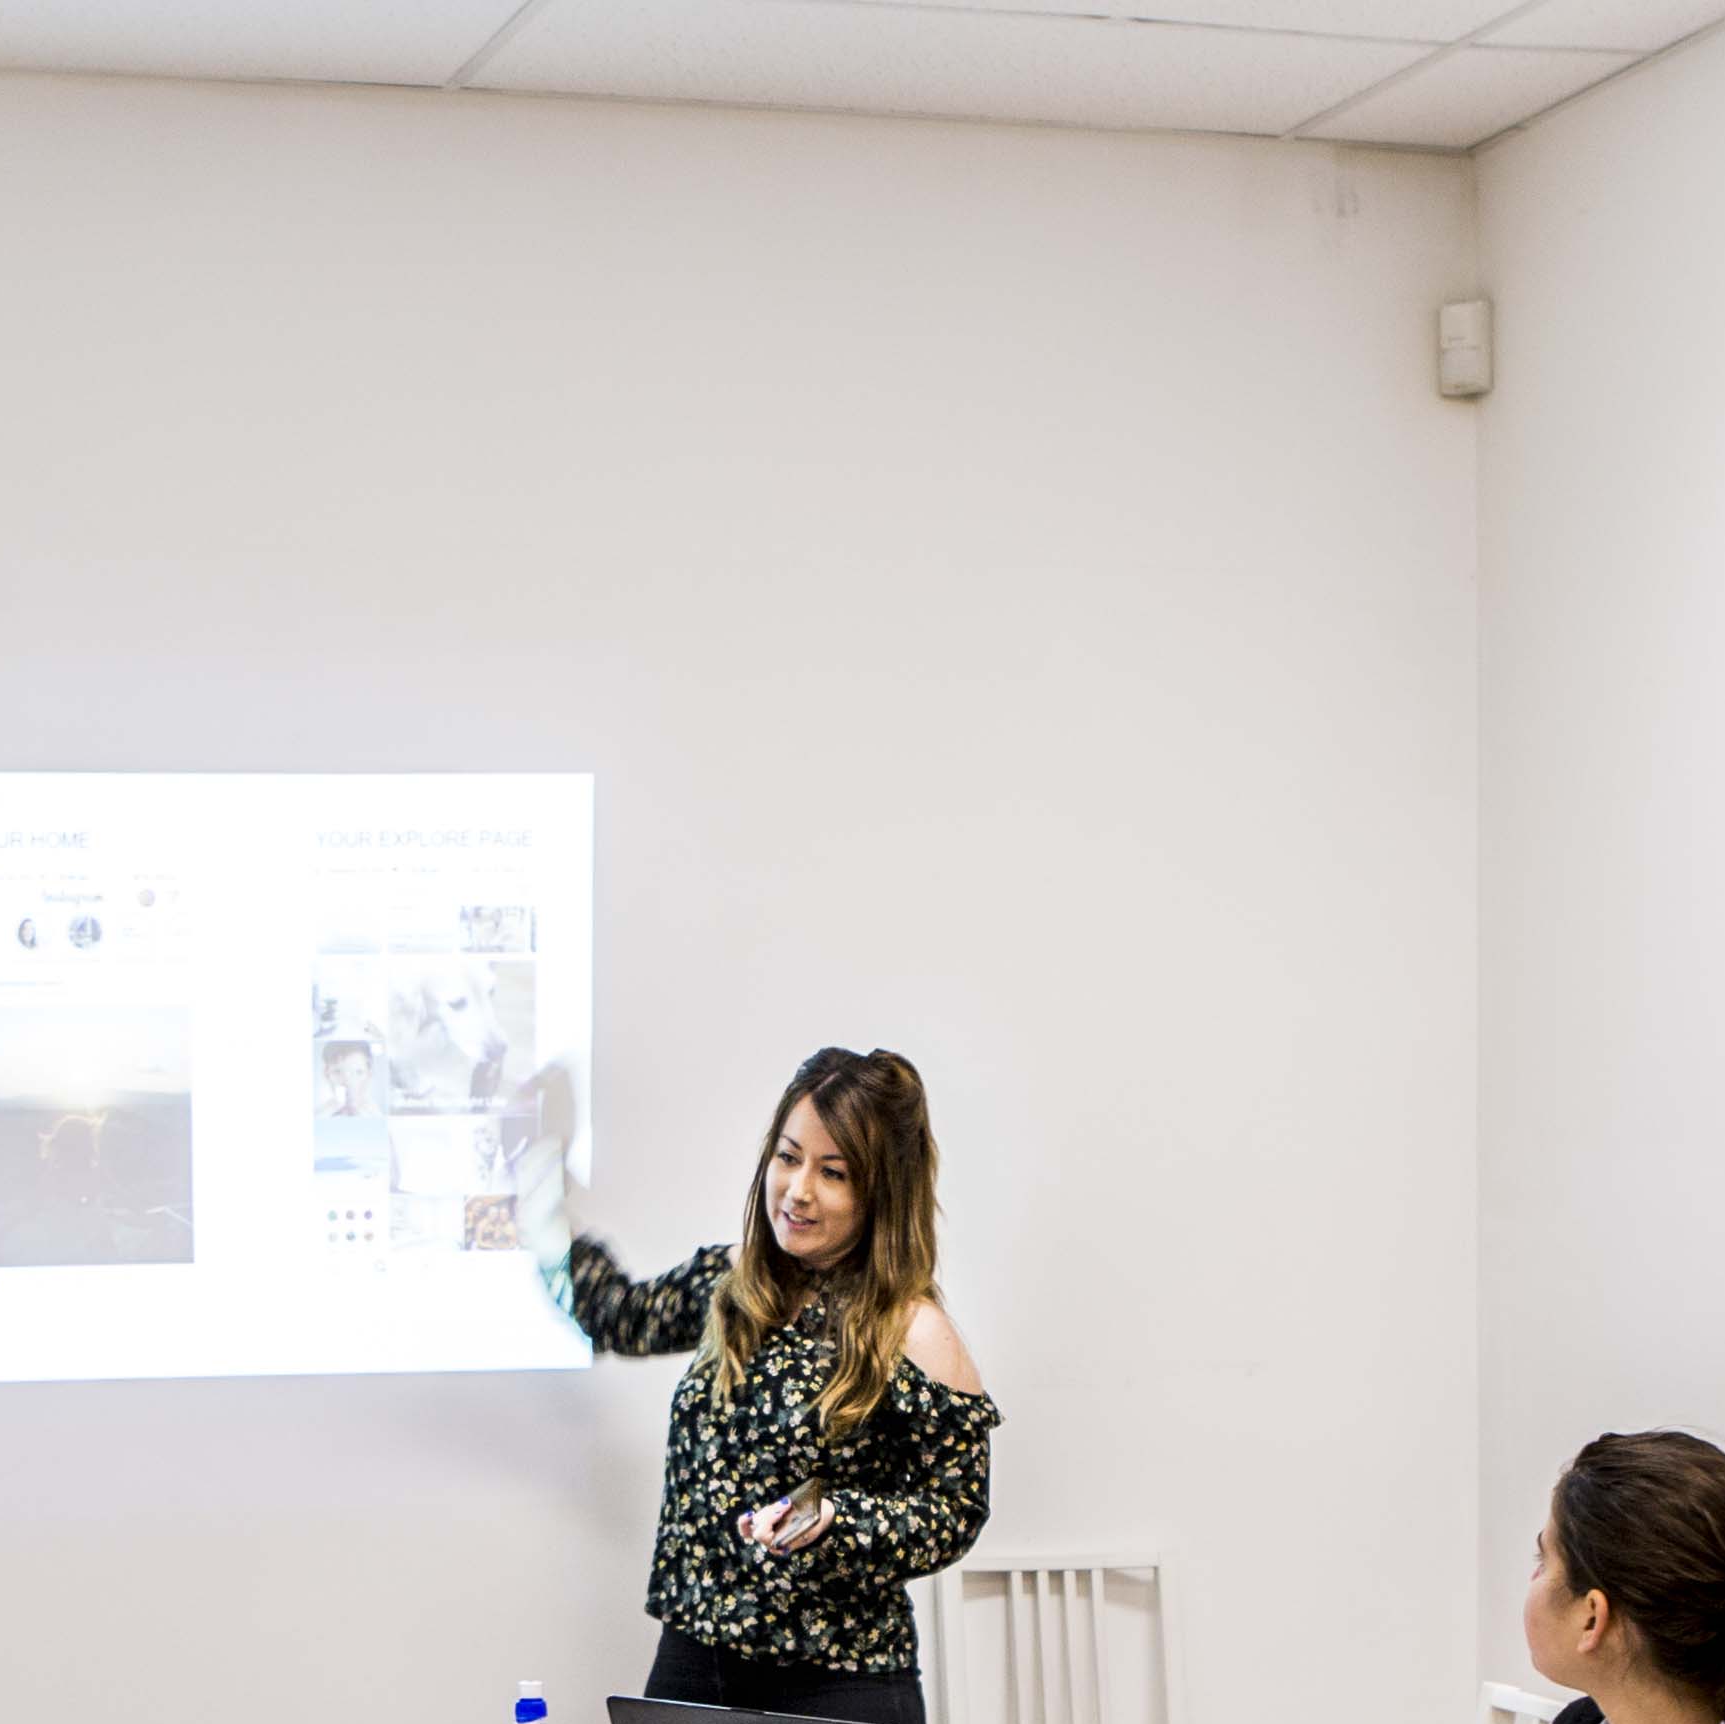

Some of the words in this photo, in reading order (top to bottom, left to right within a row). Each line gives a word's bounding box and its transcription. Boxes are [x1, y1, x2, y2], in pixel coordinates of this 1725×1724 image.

[30, 831, 90, 849] HOME
[316, 830, 373, 848] YOUR
[379, 830, 470, 848] EXPLORE
[478, 830, 533, 848] PAGE
